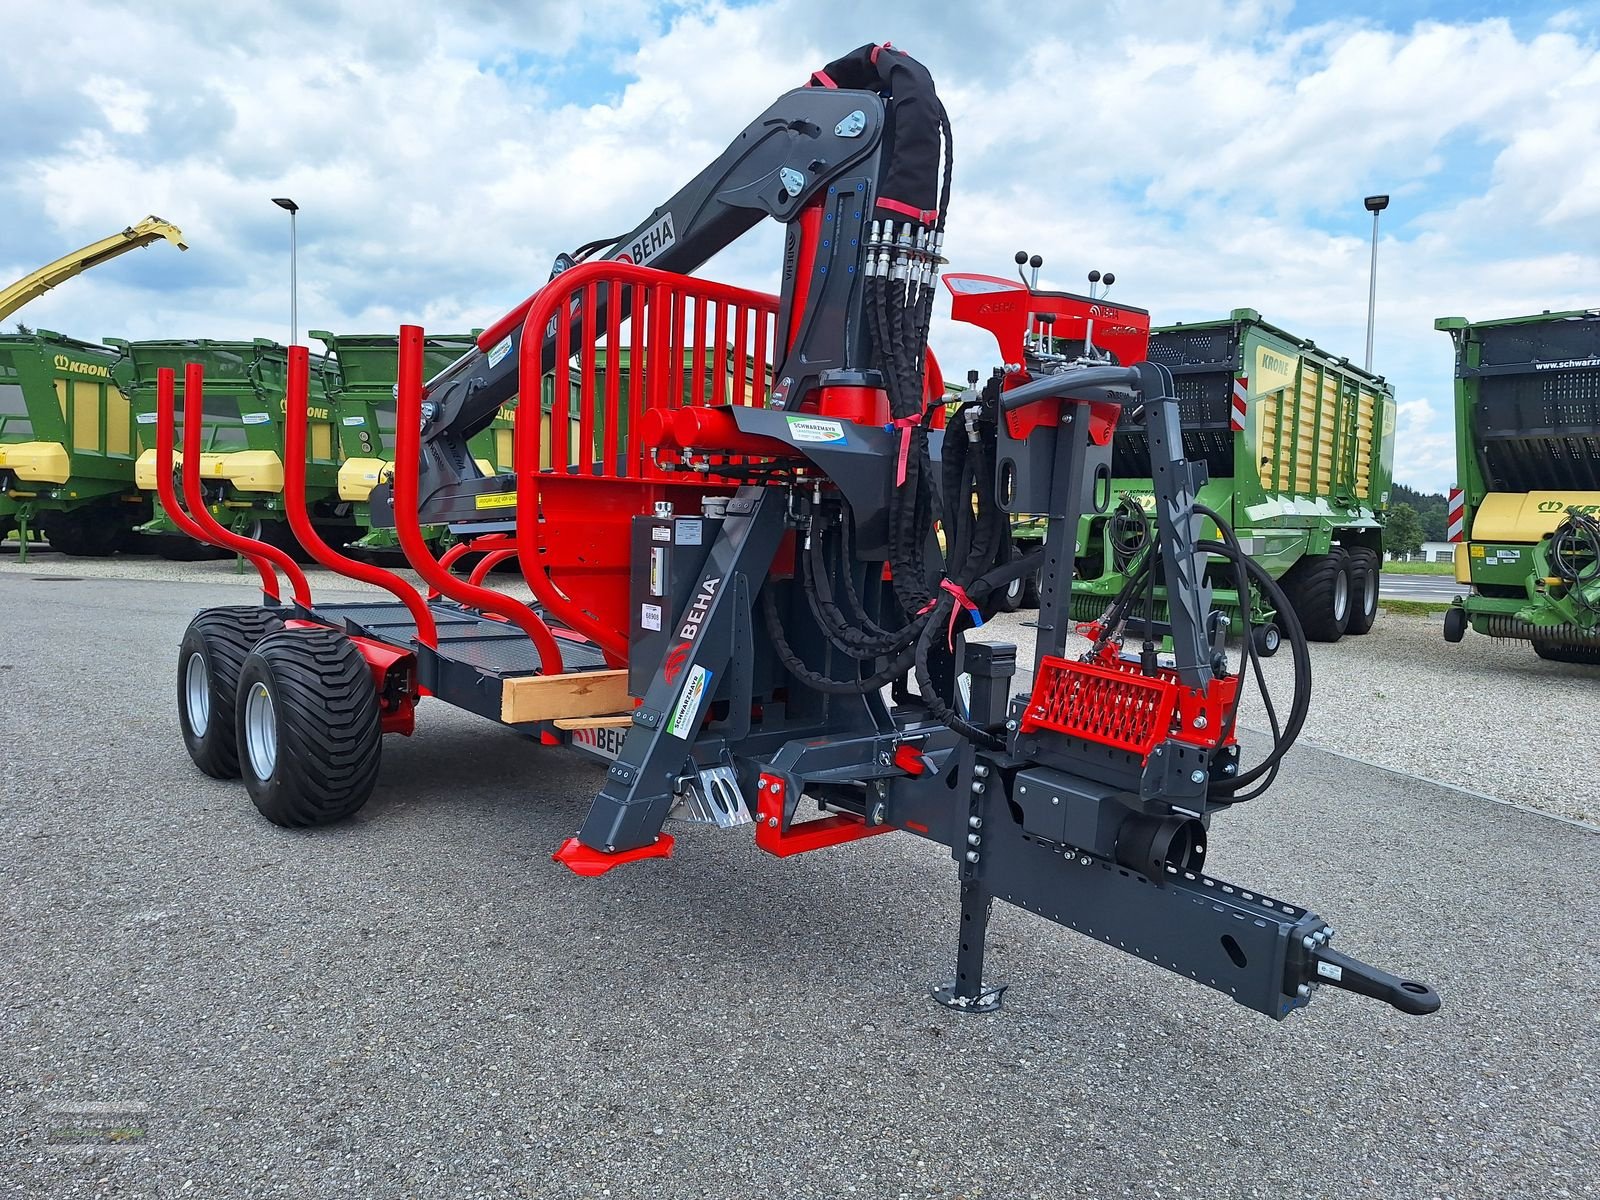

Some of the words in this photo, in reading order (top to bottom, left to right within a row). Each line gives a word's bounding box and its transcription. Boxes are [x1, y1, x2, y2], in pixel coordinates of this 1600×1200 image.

[631, 220, 673, 265] BEHA
[69, 361, 110, 378] KRON
[1262, 353, 1289, 377] KRONE
[307, 406, 328, 419] ONE
[793, 422, 836, 432] SCHWARZMAYR
[680, 576, 721, 640] BEHA
[674, 675, 699, 729] SCHWARZMAYR
[597, 728, 625, 755] BEH
